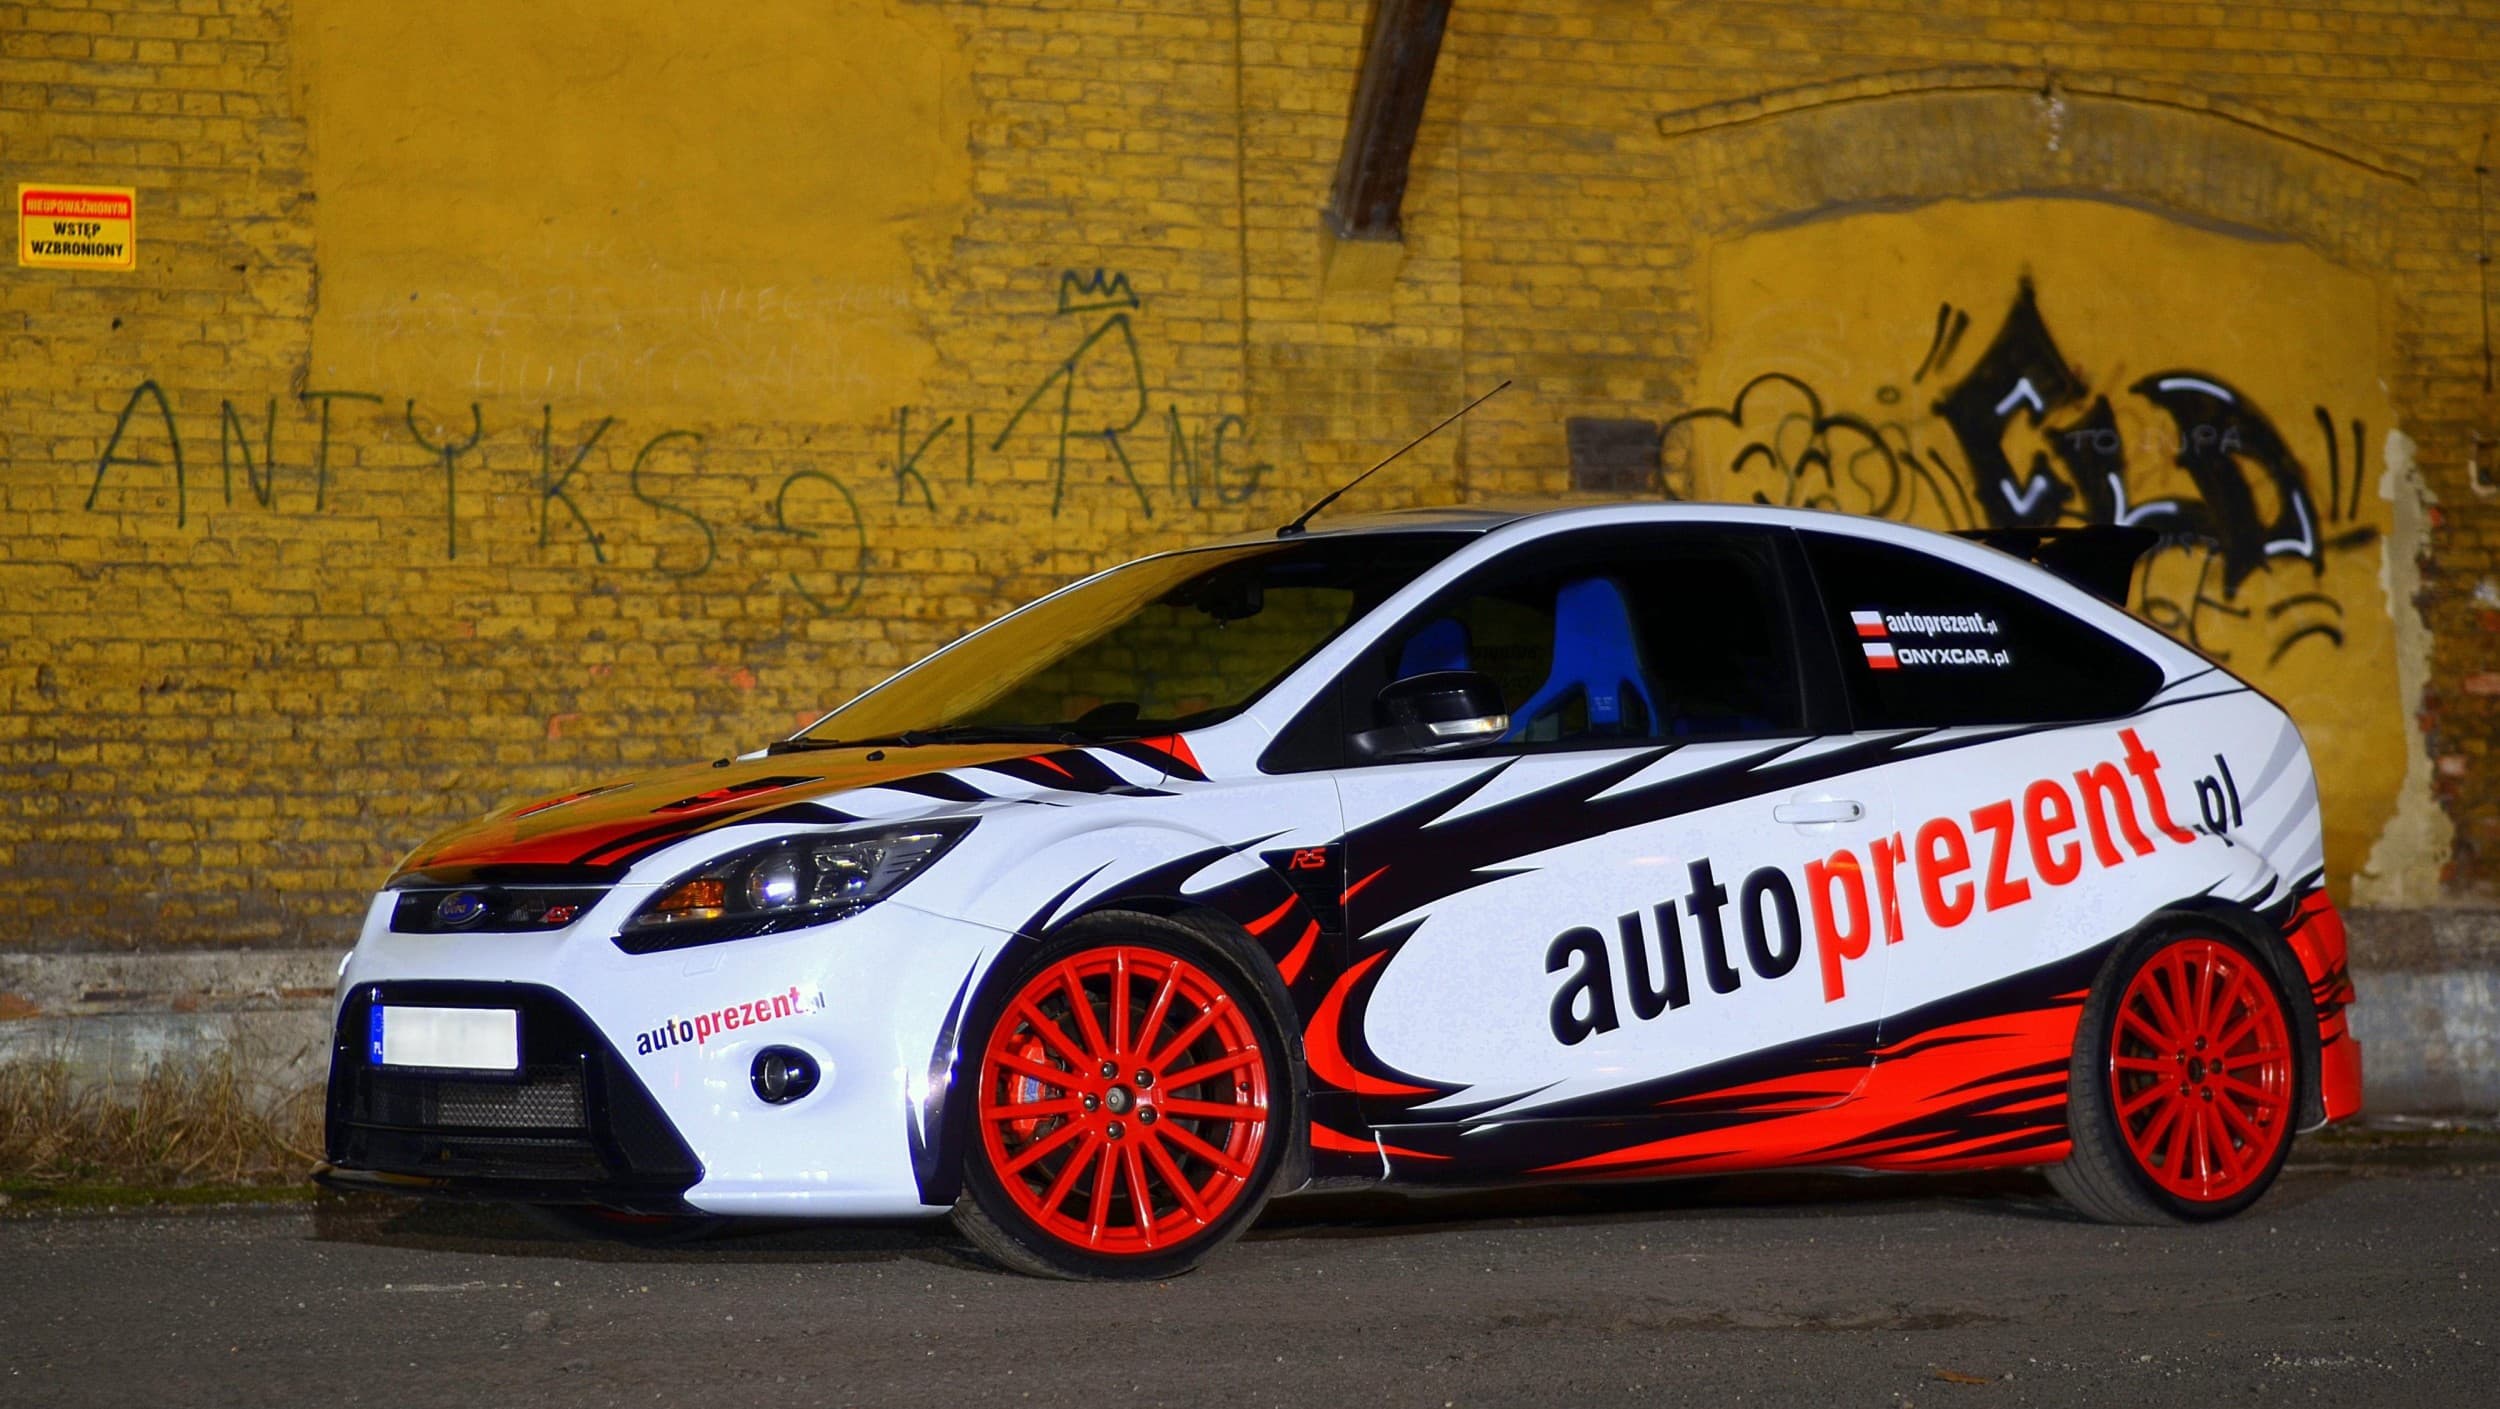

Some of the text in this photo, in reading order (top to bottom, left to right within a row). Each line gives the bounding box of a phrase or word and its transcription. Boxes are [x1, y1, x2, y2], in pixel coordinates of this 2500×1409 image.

[53, 221, 101, 239] WSTĘP
[31, 240, 123, 257] WZBRONIONY
[1886, 611, 1998, 637] autoprezent.pl
[1898, 648, 2010, 667] ONYXCAR.pl
[1288, 847, 1327, 870] RS
[1544, 727, 2243, 1046] autoprezent.pl
